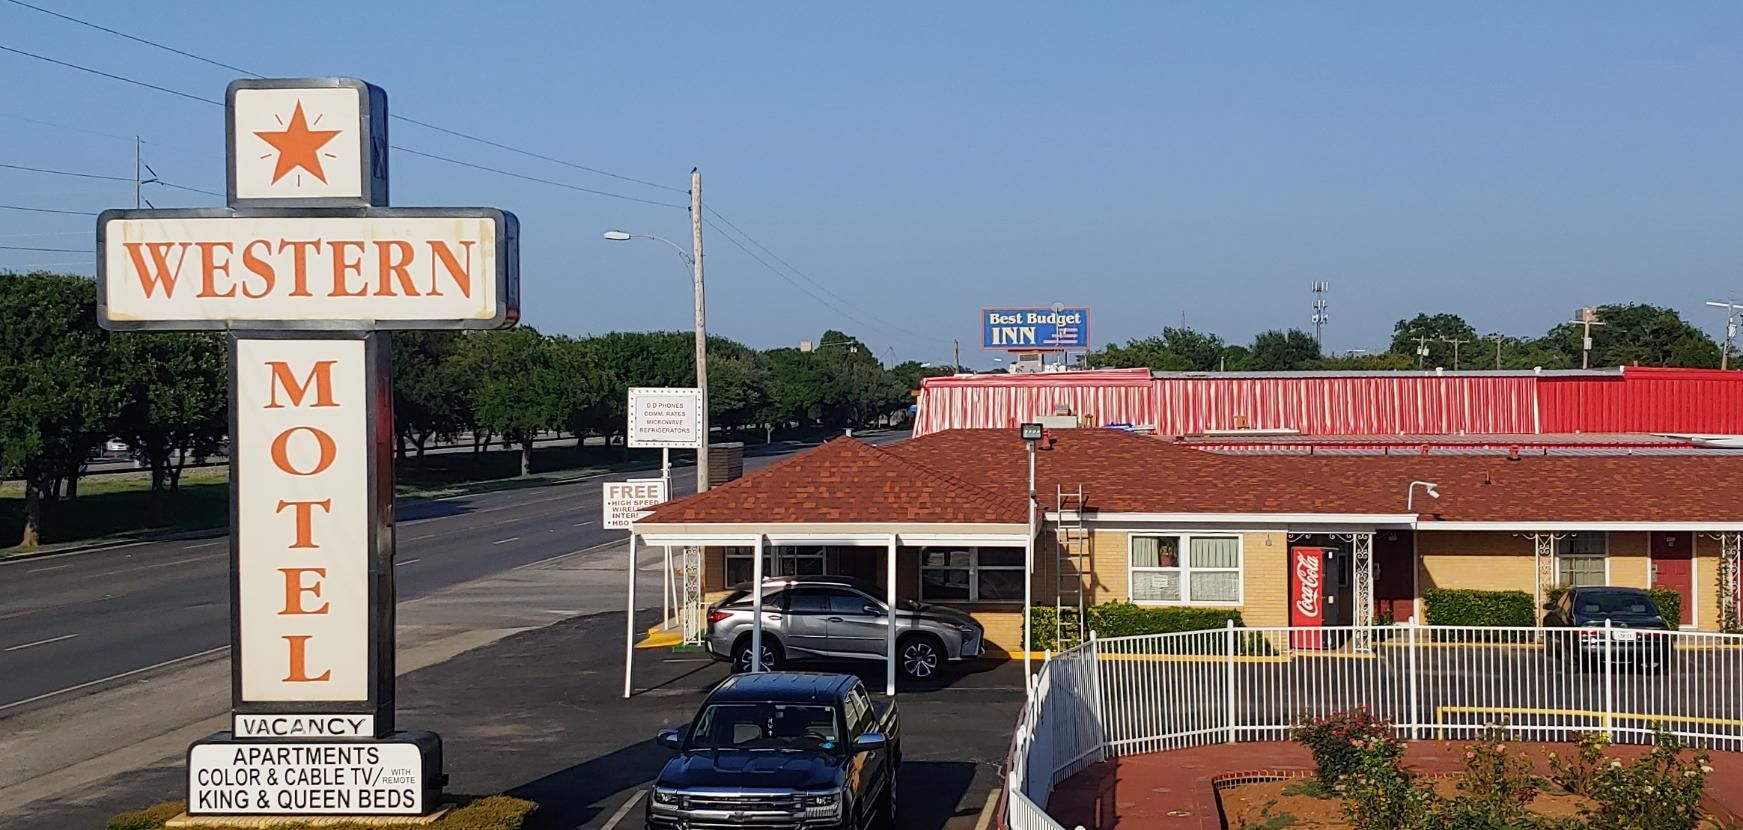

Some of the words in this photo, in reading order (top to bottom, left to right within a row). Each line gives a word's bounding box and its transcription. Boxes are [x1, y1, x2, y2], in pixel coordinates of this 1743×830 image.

[122, 238, 476, 299] WESTERN
[989, 313, 1023, 325] Best
[1027, 312, 1081, 327] Budget
[991, 326, 1037, 345] INN
[610, 485, 659, 499] FREE
[263, 360, 341, 683] MOTEL
[1296, 551, 1319, 617] Coca-Cola
[243, 718, 366, 736] VACANCY
[233, 747, 380, 765] APARTMENTS
[198, 768, 261, 786] COLOR
[267, 768, 279, 786] &
[284, 767, 345, 786] CABLE
[382, 776, 416, 784] REMOTE
[391, 768, 411, 776] WITH
[199, 789, 249, 809] KING
[257, 789, 270, 809] &
[277, 789, 350, 810] QUEEN
[359, 789, 415, 809] BEDS
